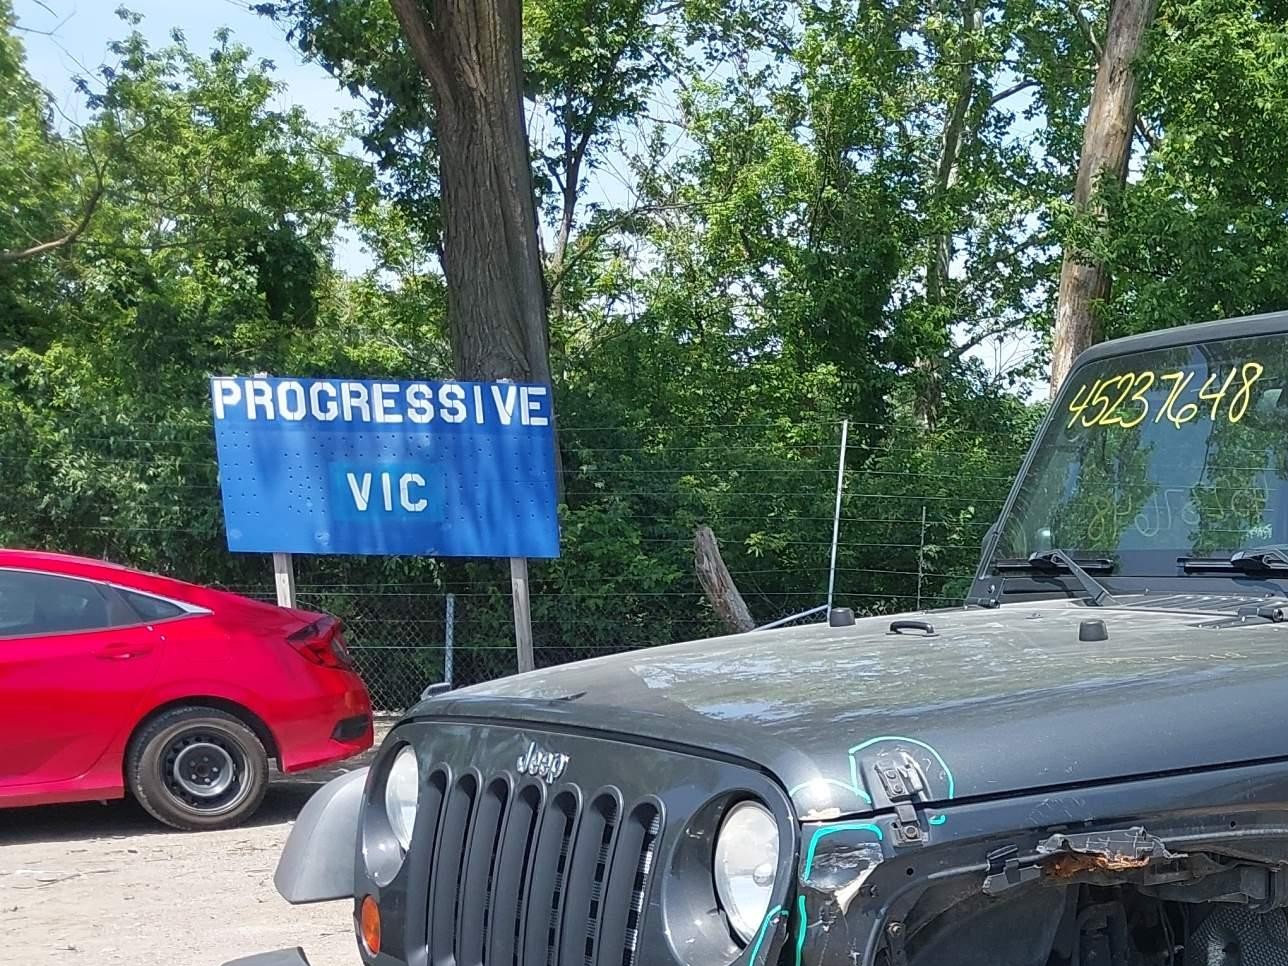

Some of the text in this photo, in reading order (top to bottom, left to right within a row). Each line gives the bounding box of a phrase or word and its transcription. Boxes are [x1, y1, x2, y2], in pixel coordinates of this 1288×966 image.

[213, 379, 549, 426] PROGRESSIVE
[1067, 362, 1264, 429] 45237648
[346, 472, 428, 512] VIC
[516, 741, 570, 784] Jeep
